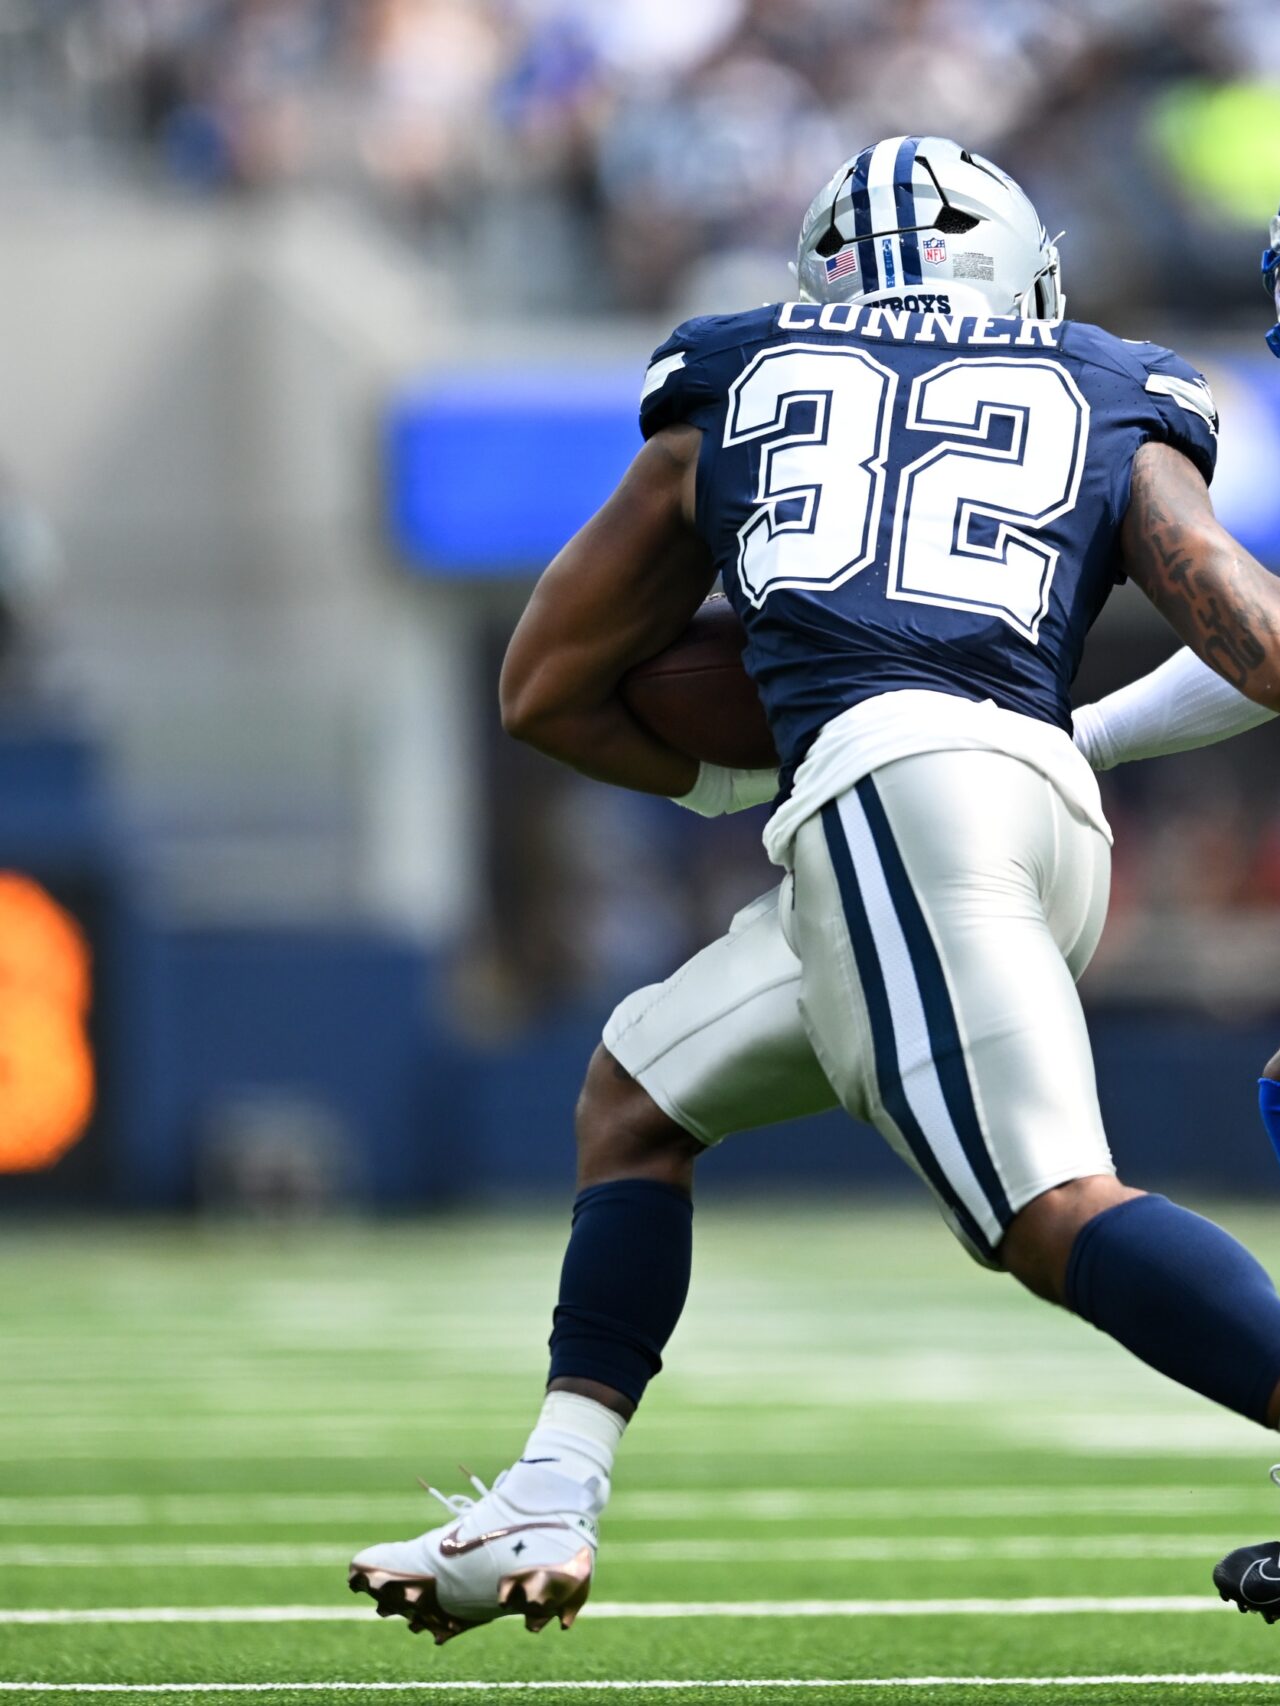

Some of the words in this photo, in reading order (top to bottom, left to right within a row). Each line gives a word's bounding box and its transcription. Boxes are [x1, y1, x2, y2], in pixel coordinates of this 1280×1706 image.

[926, 248, 945, 262] NFL
[778, 302, 1061, 346] CONNER
[722, 342, 1090, 645] 32
